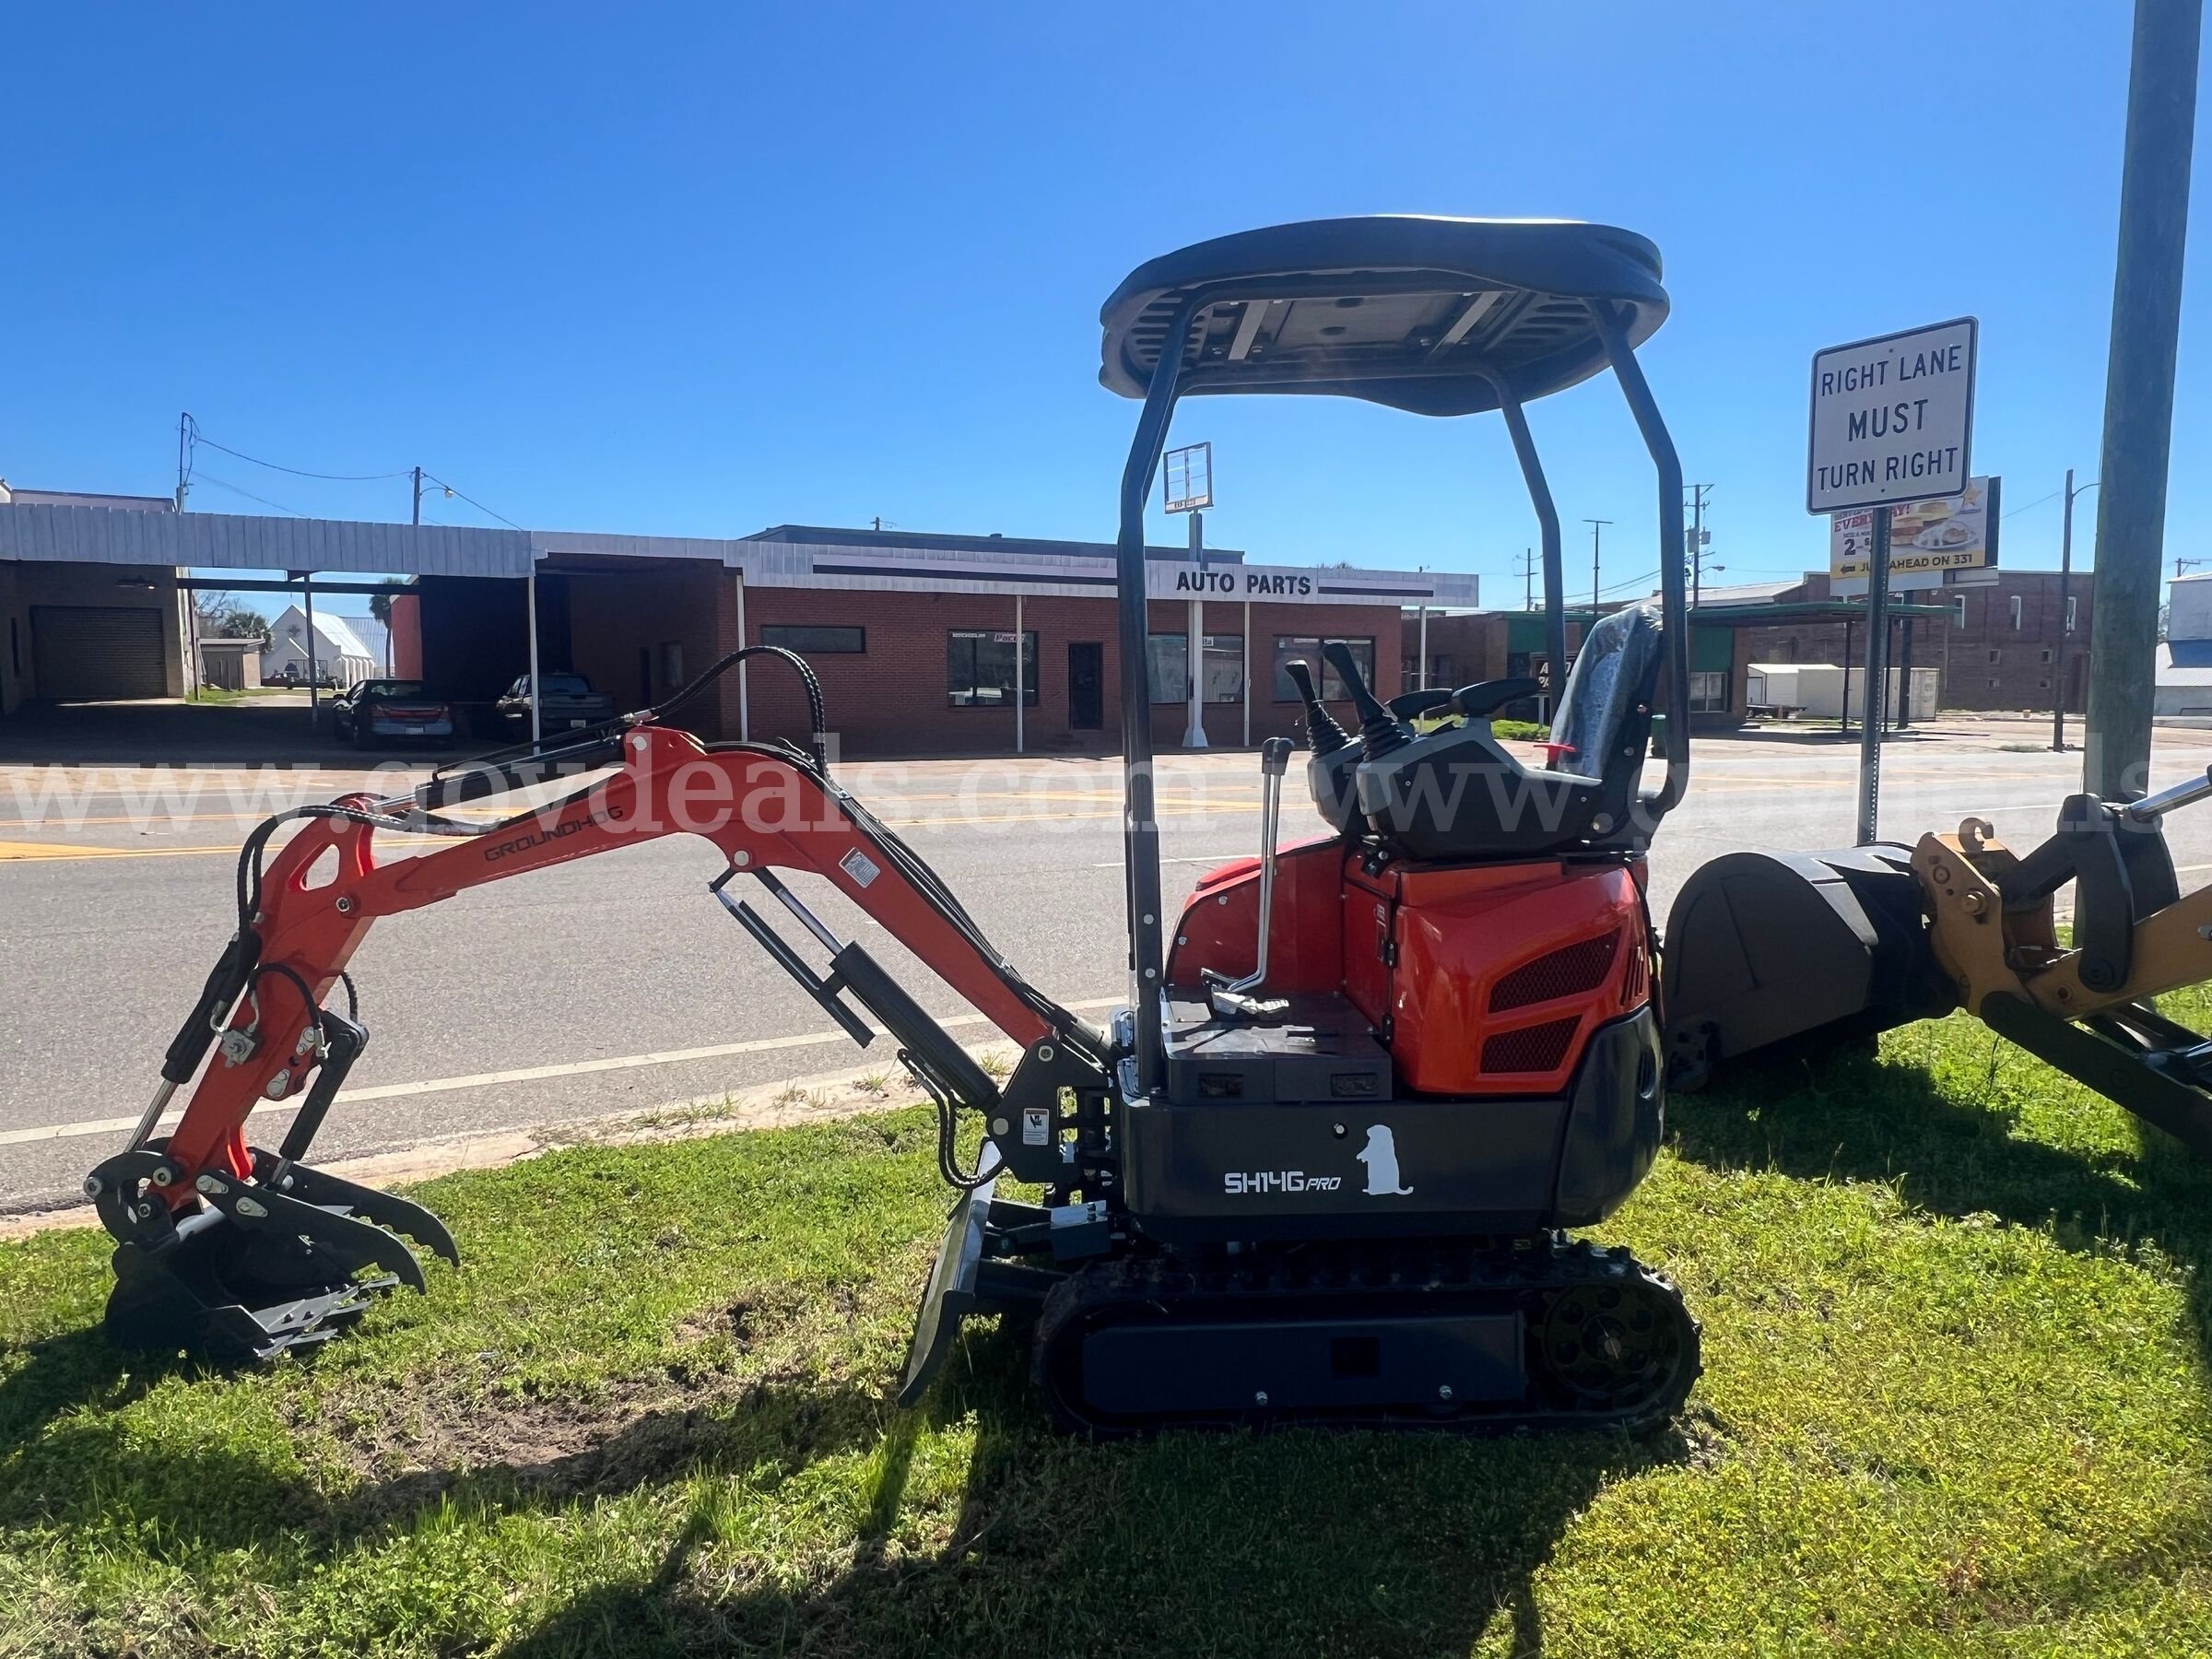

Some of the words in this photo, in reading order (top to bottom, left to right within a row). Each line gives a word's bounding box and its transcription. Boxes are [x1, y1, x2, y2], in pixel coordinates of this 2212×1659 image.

[1821, 360, 1889, 396] RIGHT
[1900, 346, 1962, 382] LANE
[1848, 399, 1929, 441] MUST
[1818, 460, 1876, 490] TURN
[1886, 447, 1959, 481] RIGHT
[1844, 538, 1856, 556] 2
[1889, 558, 1929, 569] AHEAD
[1932, 555, 1950, 566] ON
[1954, 554, 1972, 564] 331
[1176, 571, 1235, 593] AUTO
[1247, 574, 1311, 595] PARTS
[484, 806, 624, 861] GROUNDHOG
[1224, 1171, 1304, 1194] SH14G
[1305, 1177, 1342, 1191] PRO
